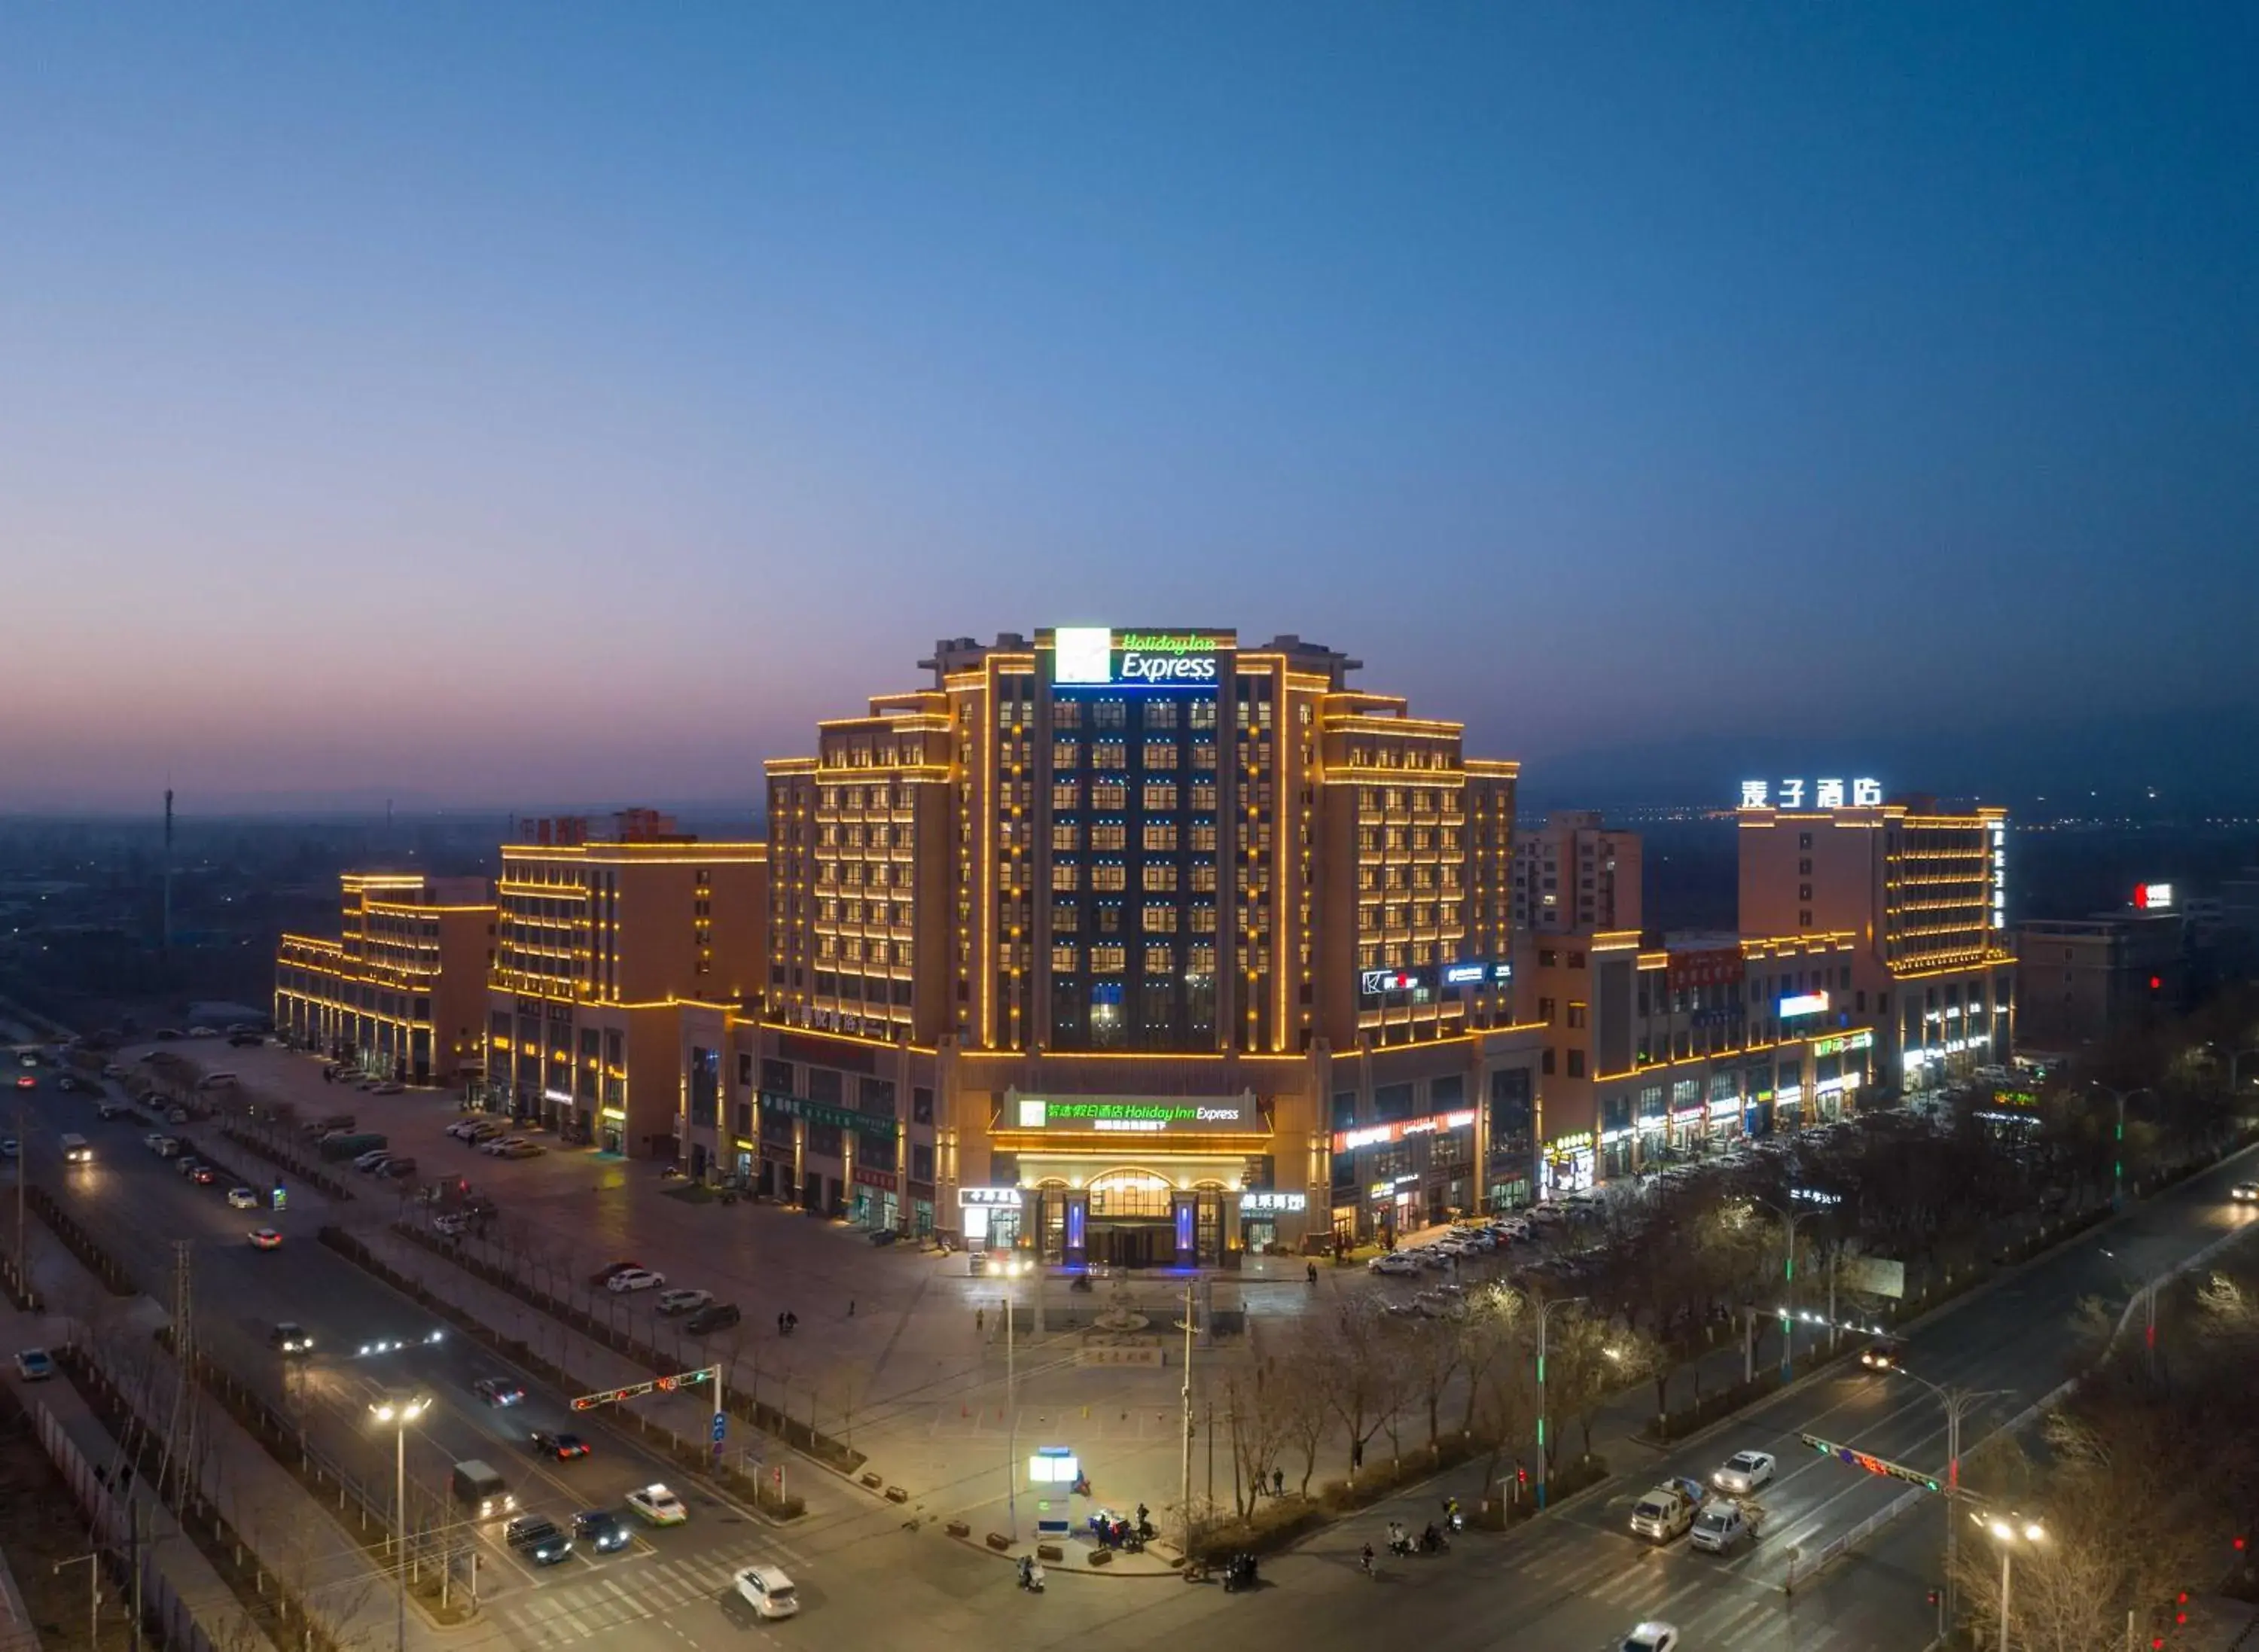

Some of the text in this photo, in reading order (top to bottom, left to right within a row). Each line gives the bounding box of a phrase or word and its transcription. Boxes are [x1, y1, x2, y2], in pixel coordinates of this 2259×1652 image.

[1122, 634, 1216, 654] Holiday Inn
[1122, 654, 1215, 682] Express
[1741, 778, 1882, 808] 麦子酒店
[1125, 1105, 1175, 1121] Holiday
[1175, 1105, 1196, 1118] Inn
[1197, 1107, 1239, 1121] Express
